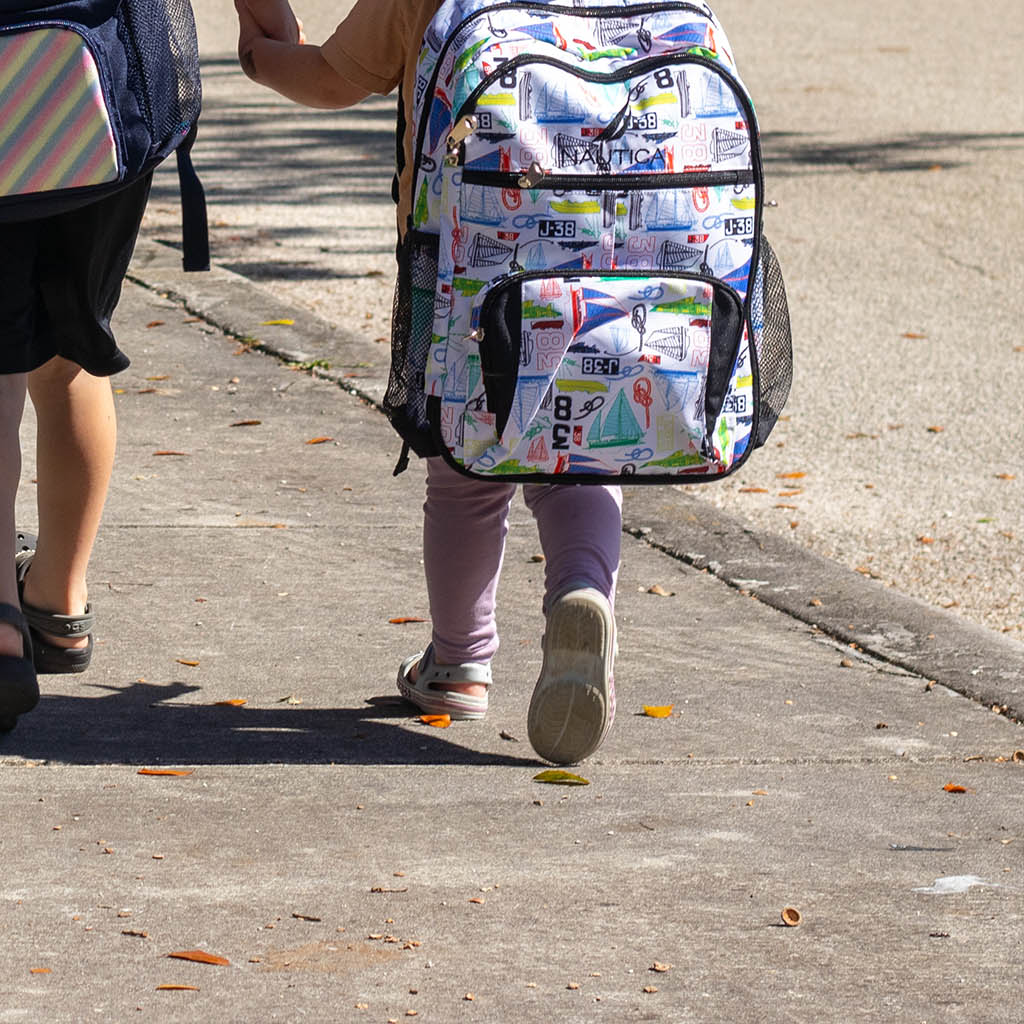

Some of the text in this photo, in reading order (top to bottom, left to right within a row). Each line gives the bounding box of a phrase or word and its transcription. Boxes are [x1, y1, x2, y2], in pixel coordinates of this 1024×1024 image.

[561, 148, 666, 167] NAUTICA
[540, 222, 575, 237] J-38
[726, 218, 753, 236] J-38
[583, 358, 617, 374] J-38
